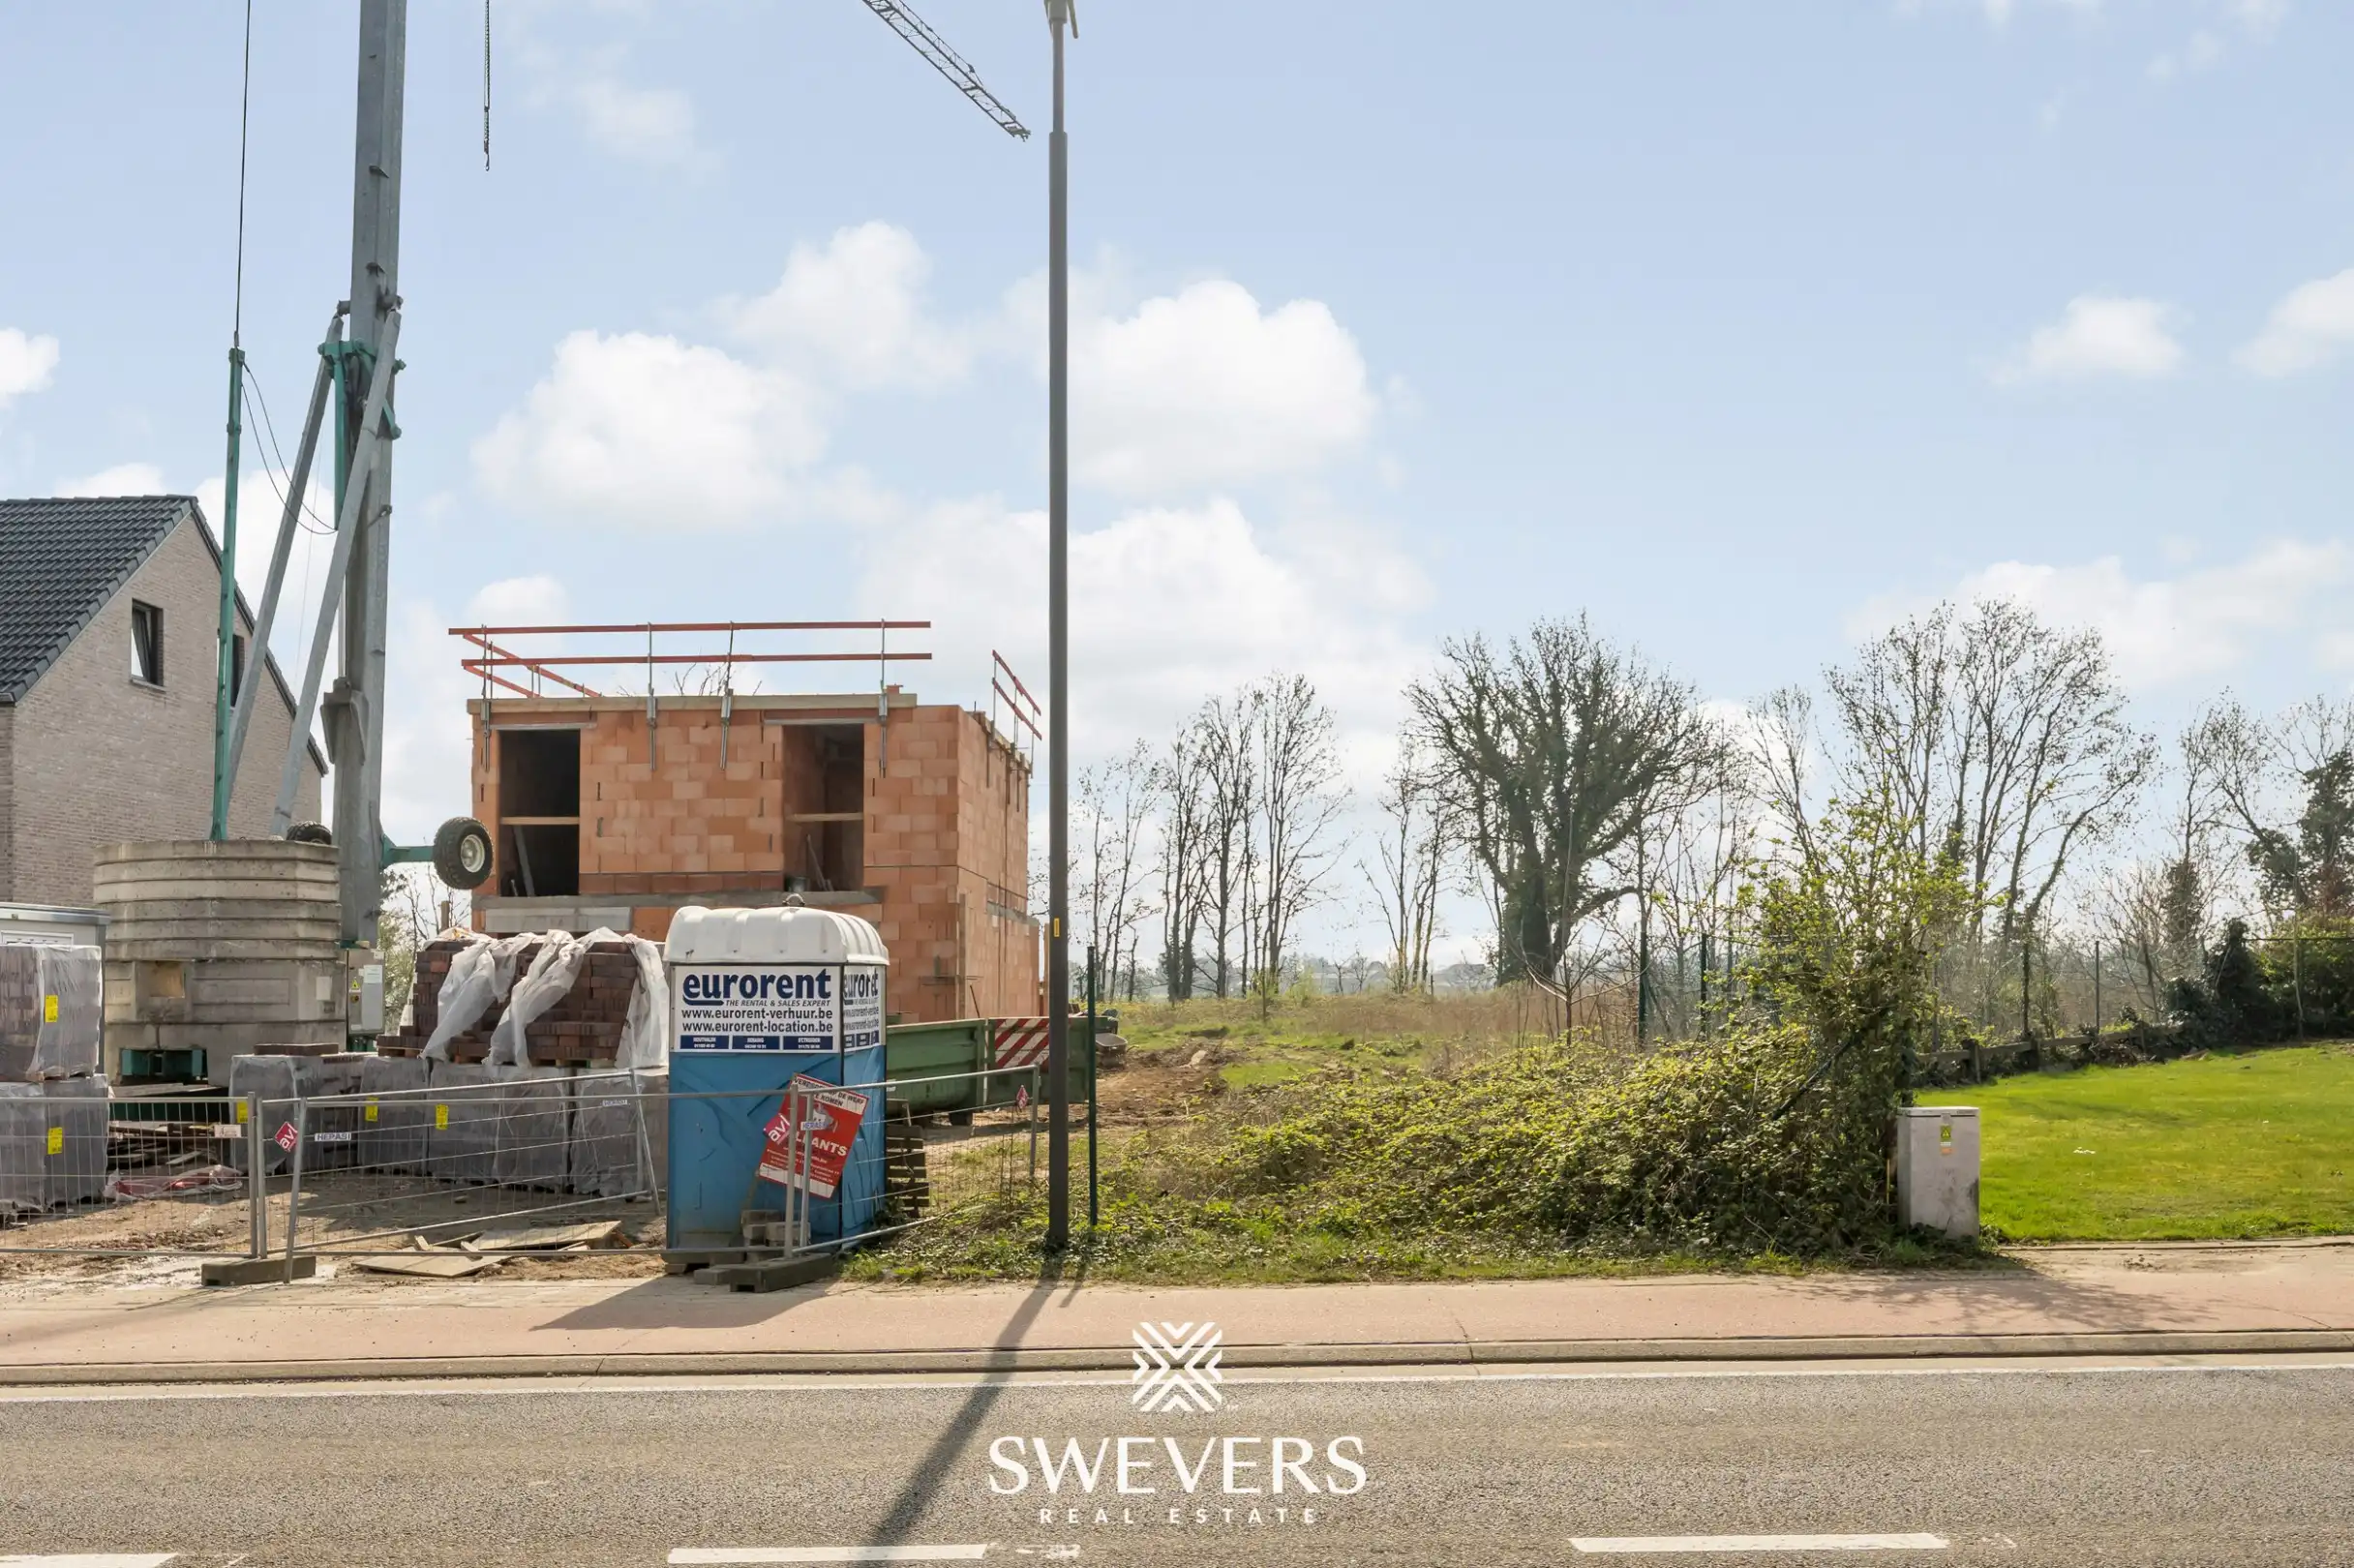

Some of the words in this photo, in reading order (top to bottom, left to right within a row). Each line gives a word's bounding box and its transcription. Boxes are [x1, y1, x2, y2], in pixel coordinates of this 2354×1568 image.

[683, 969, 831, 999] eurorent
[681, 1007, 833, 1019] www.eurorent-verhuur.be
[682, 1020, 833, 1033] www.eurorent-location.be
[279, 1123, 298, 1149] avl
[768, 1114, 791, 1142] avl
